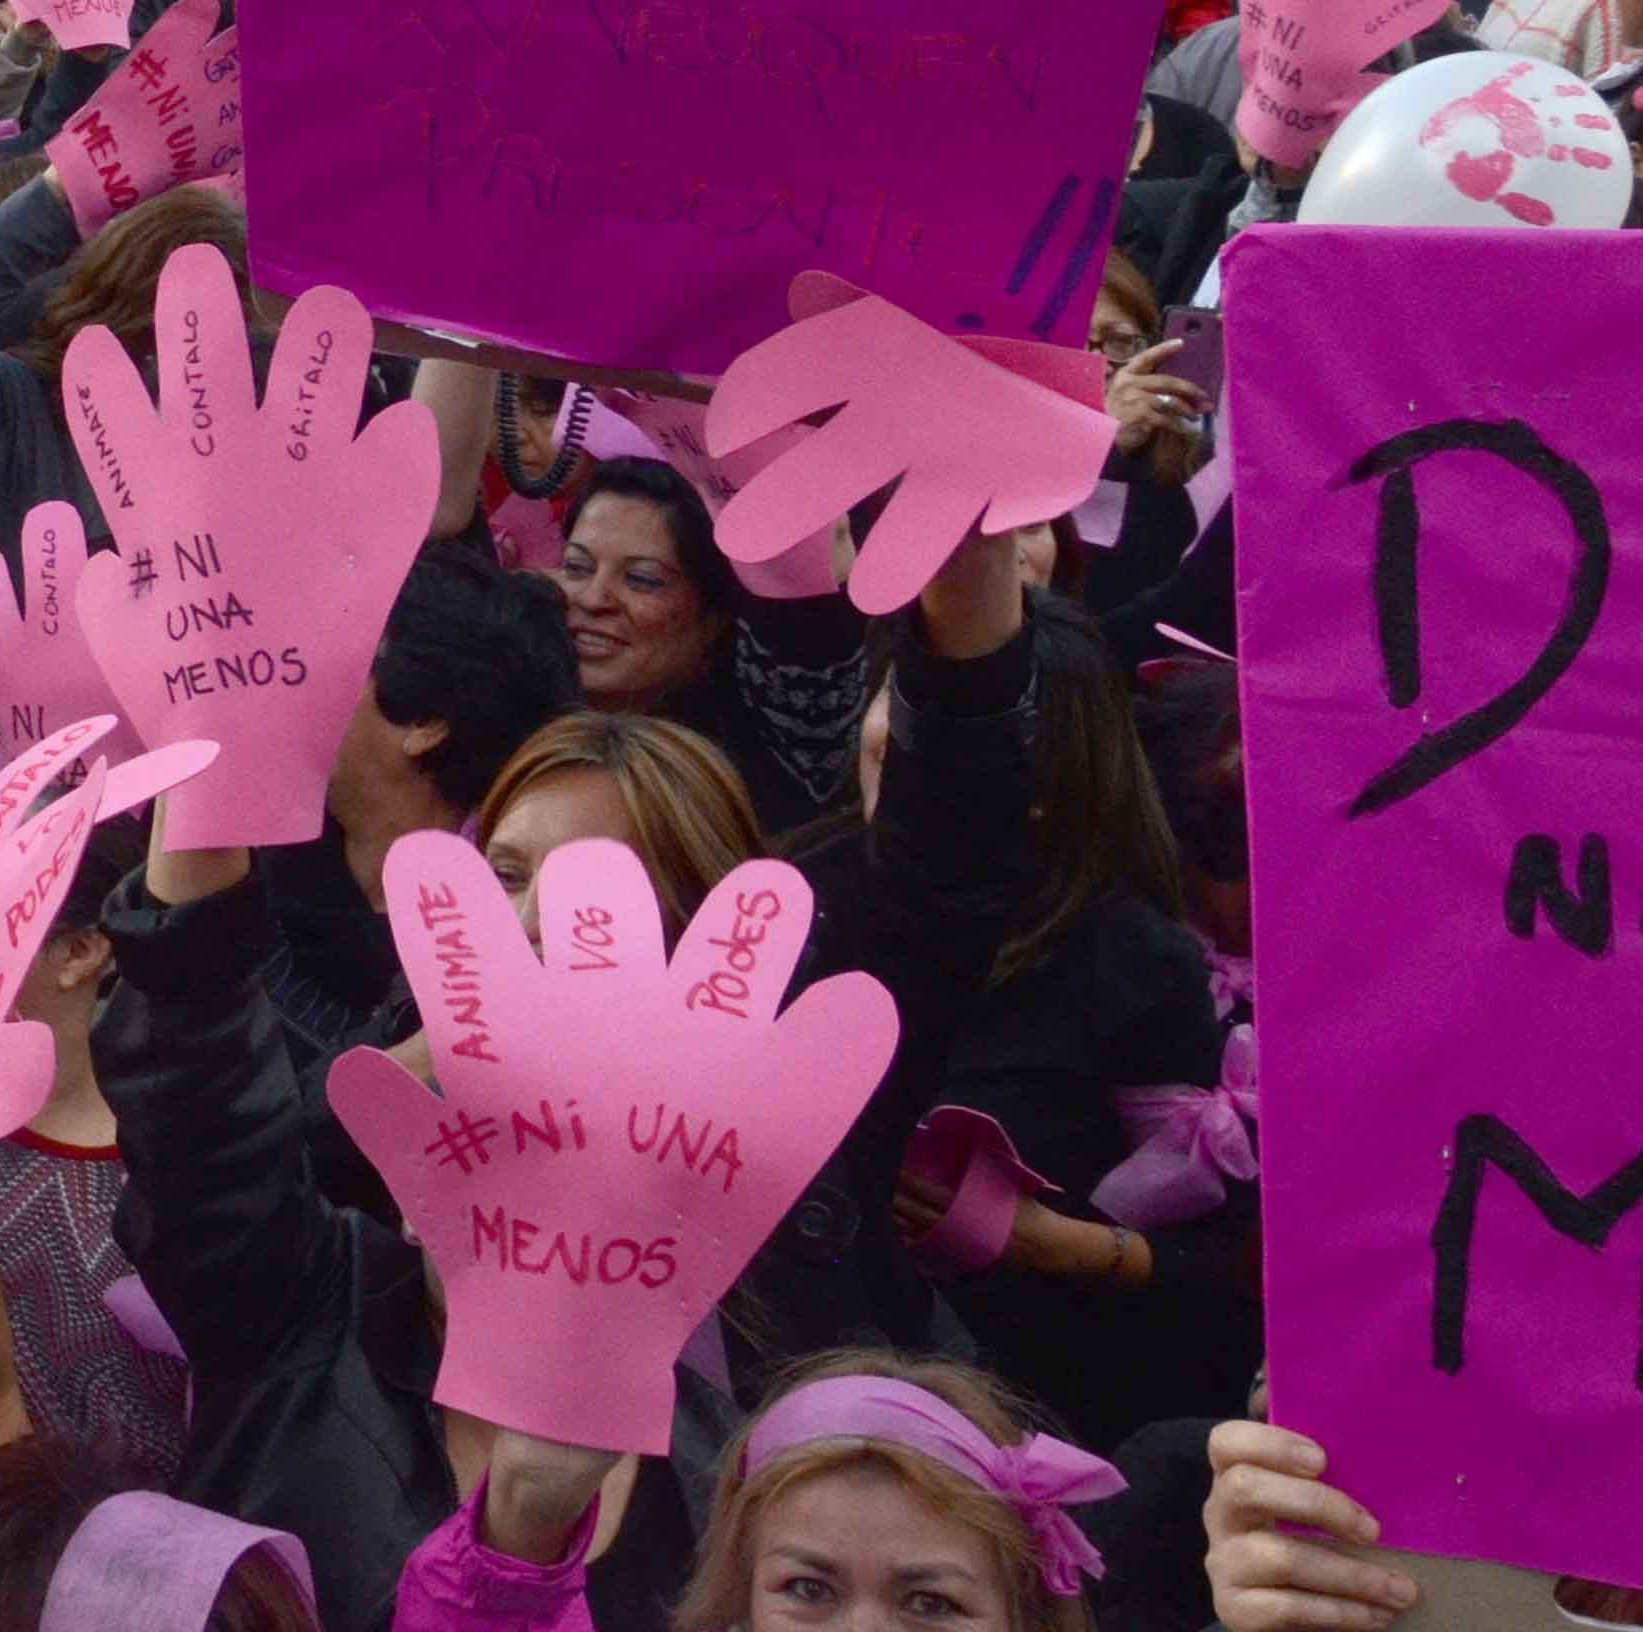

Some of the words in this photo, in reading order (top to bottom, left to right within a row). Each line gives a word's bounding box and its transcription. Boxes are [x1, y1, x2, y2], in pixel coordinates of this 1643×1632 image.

[71, 108, 141, 210] MENO
[190, 309, 216, 457] CONTALO
[41, 527, 60, 636] CONTALO
[174, 534, 221, 582] NI
[166, 592, 254, 641] UNA
[162, 646, 307, 704] MENOS
[11, 703, 46, 741] NI
[569, 904, 619, 972] VOS
[627, 1103, 745, 1194] UNA
[471, 1204, 679, 1290] MENOS
